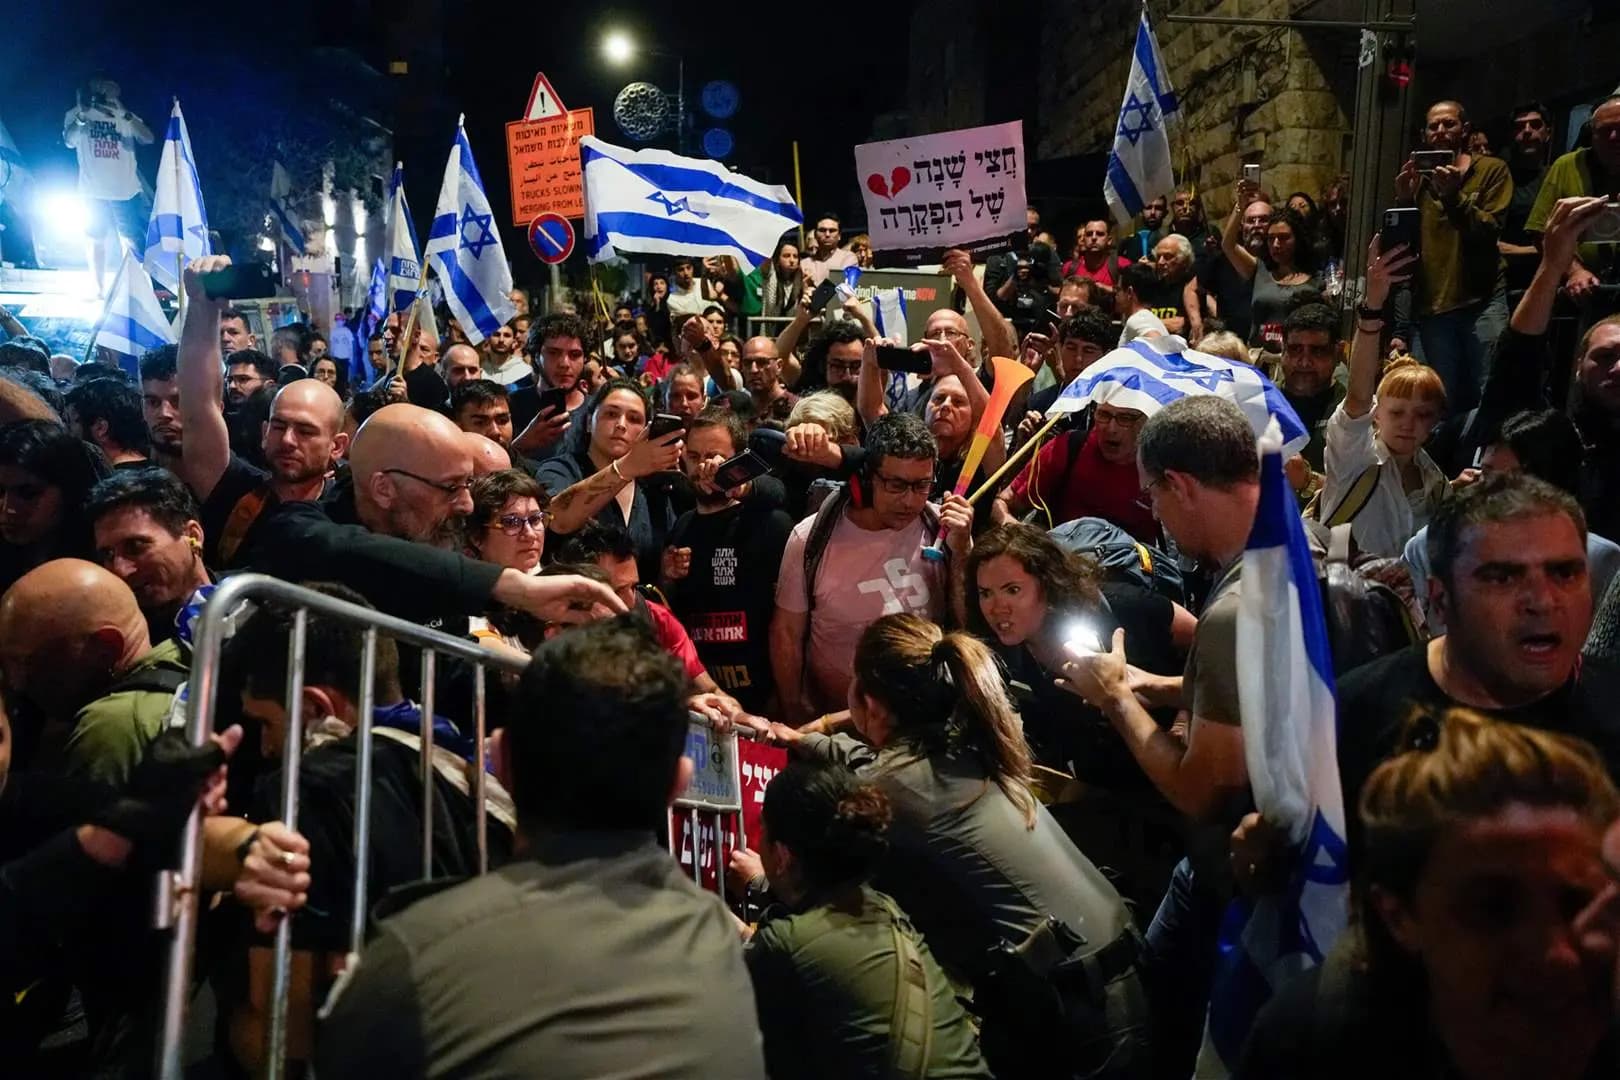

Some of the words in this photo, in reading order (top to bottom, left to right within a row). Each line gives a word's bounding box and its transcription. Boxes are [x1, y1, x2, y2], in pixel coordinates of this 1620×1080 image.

[94, 149, 120, 160] אשם
[520, 187, 551, 201] TRUCKS
[552, 183, 583, 198] SLOWIN
[520, 202, 551, 215] MERGING
[552, 199, 574, 211] FROM
[714, 548, 735, 557] אתה
[712, 557, 738, 567] הראש
[713, 567, 735, 577] אתה
[713, 576, 736, 586] אשם
[715, 626, 744, 641] אתה
